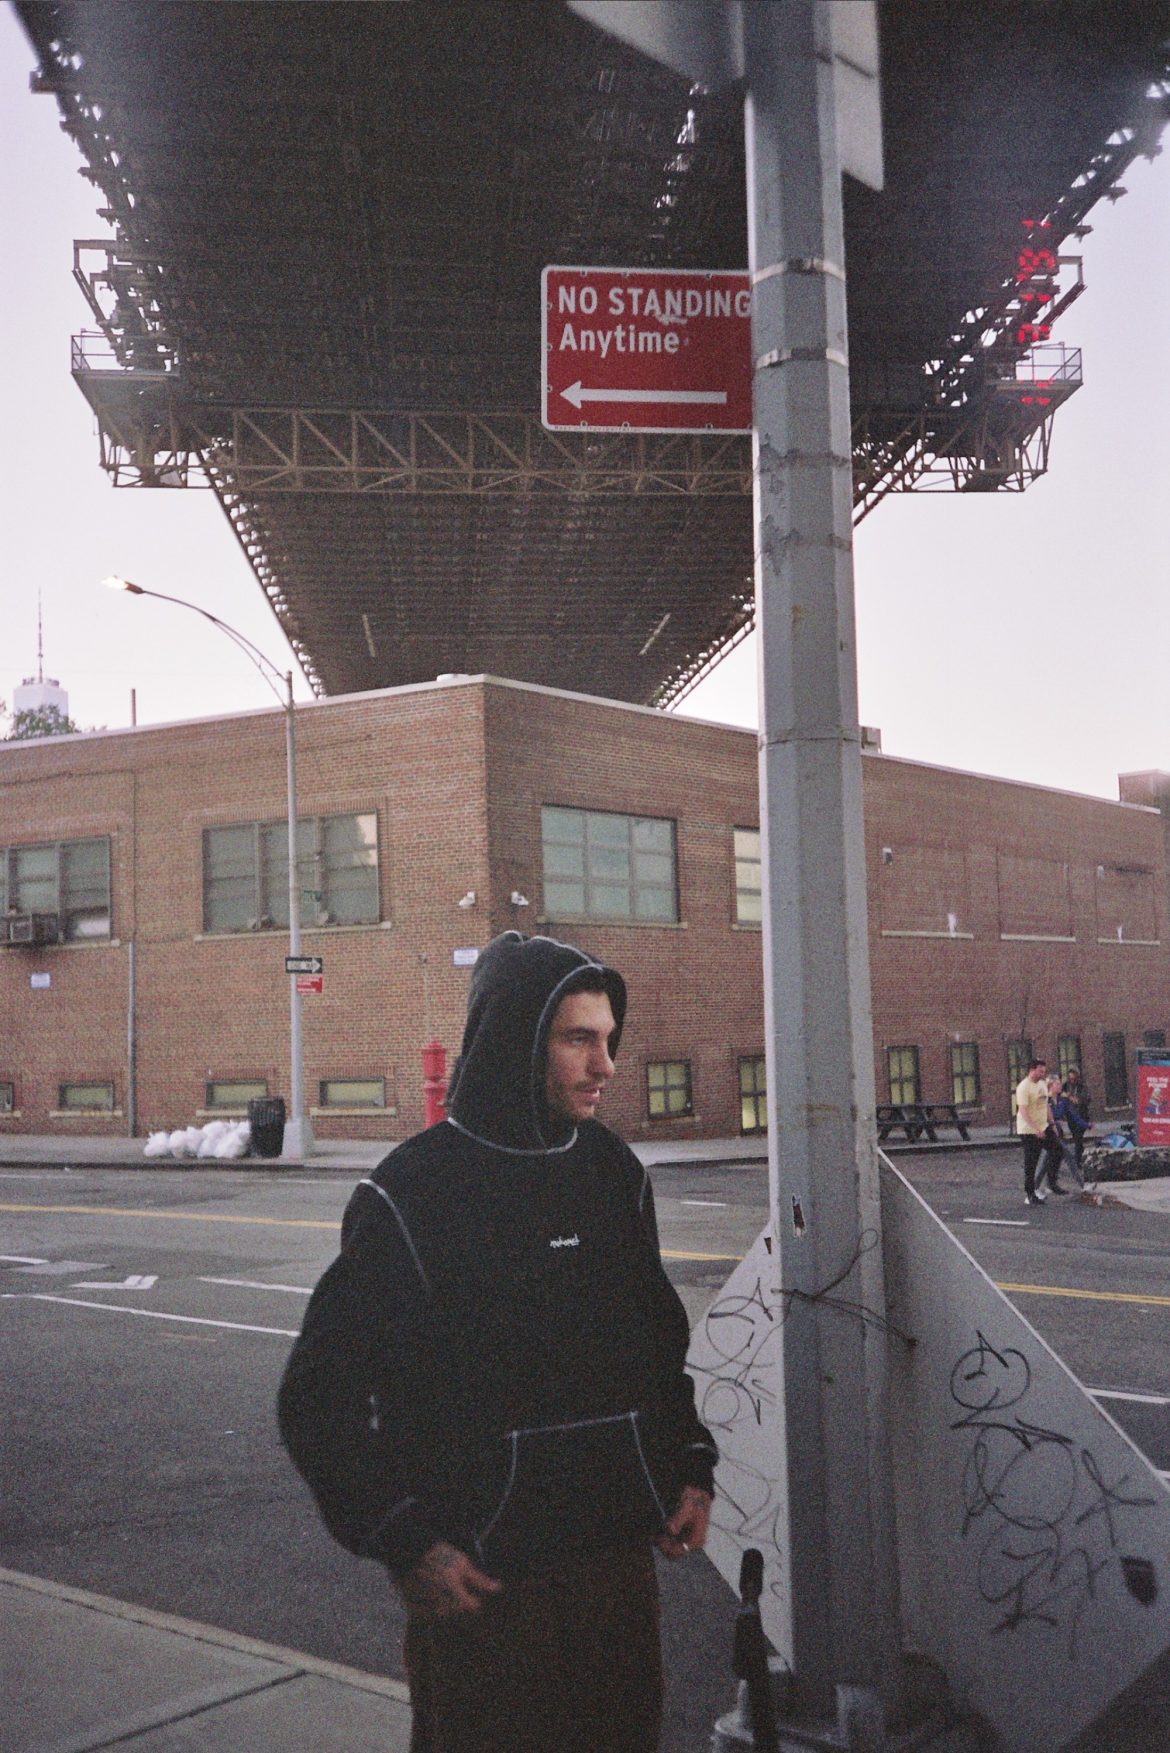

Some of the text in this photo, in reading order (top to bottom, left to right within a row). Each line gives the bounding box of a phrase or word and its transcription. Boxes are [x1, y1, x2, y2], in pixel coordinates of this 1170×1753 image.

[558, 286, 752, 318] NO STANDING
[559, 323, 680, 359] Anytime
